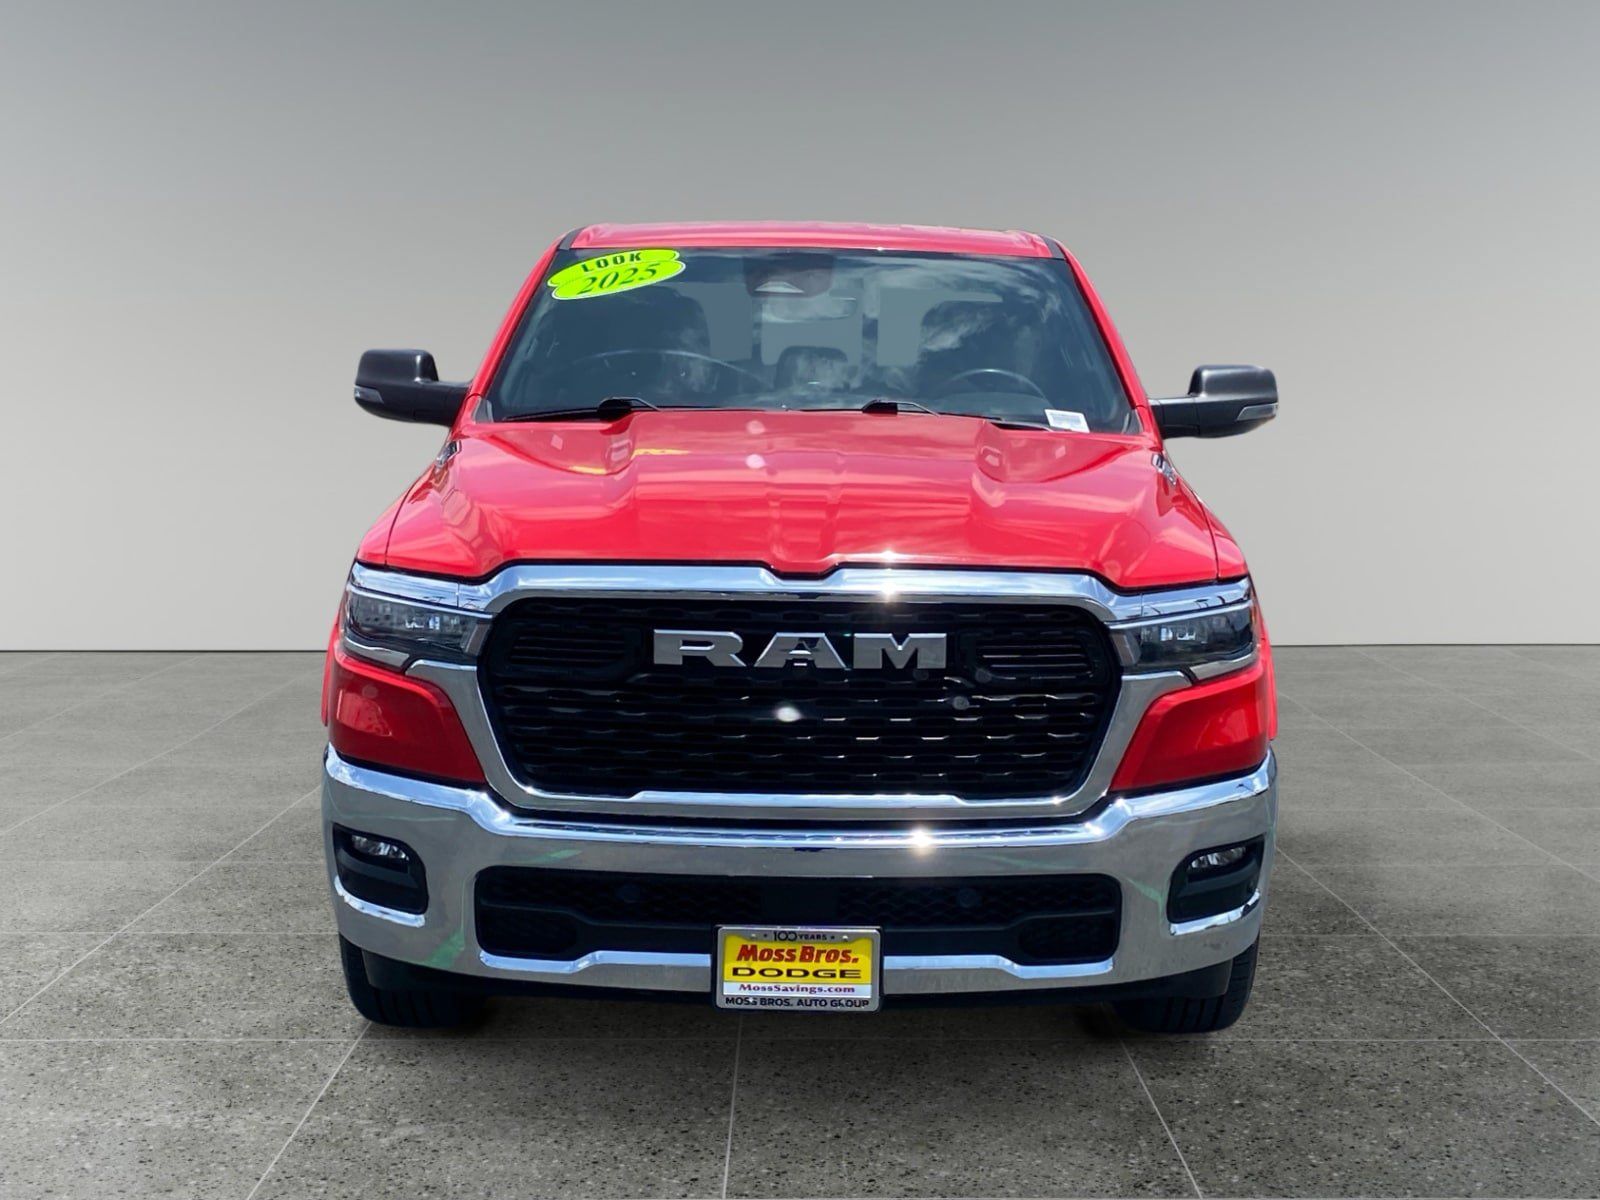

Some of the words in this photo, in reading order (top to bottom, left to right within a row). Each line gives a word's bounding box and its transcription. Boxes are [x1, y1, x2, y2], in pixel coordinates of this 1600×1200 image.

[581, 252, 642, 273] LOOK
[576, 262, 661, 295] 2025
[653, 629, 947, 670] RAM
[737, 944, 796, 962] Moss
[799, 945, 859, 963] Bros.
[732, 967, 861, 979] DODGE
[738, 983, 855, 994] MossSavings.com
[725, 996, 757, 1006] MOSS
[759, 997, 793, 1007] BROS.
[796, 999, 827, 1008] AUTO
